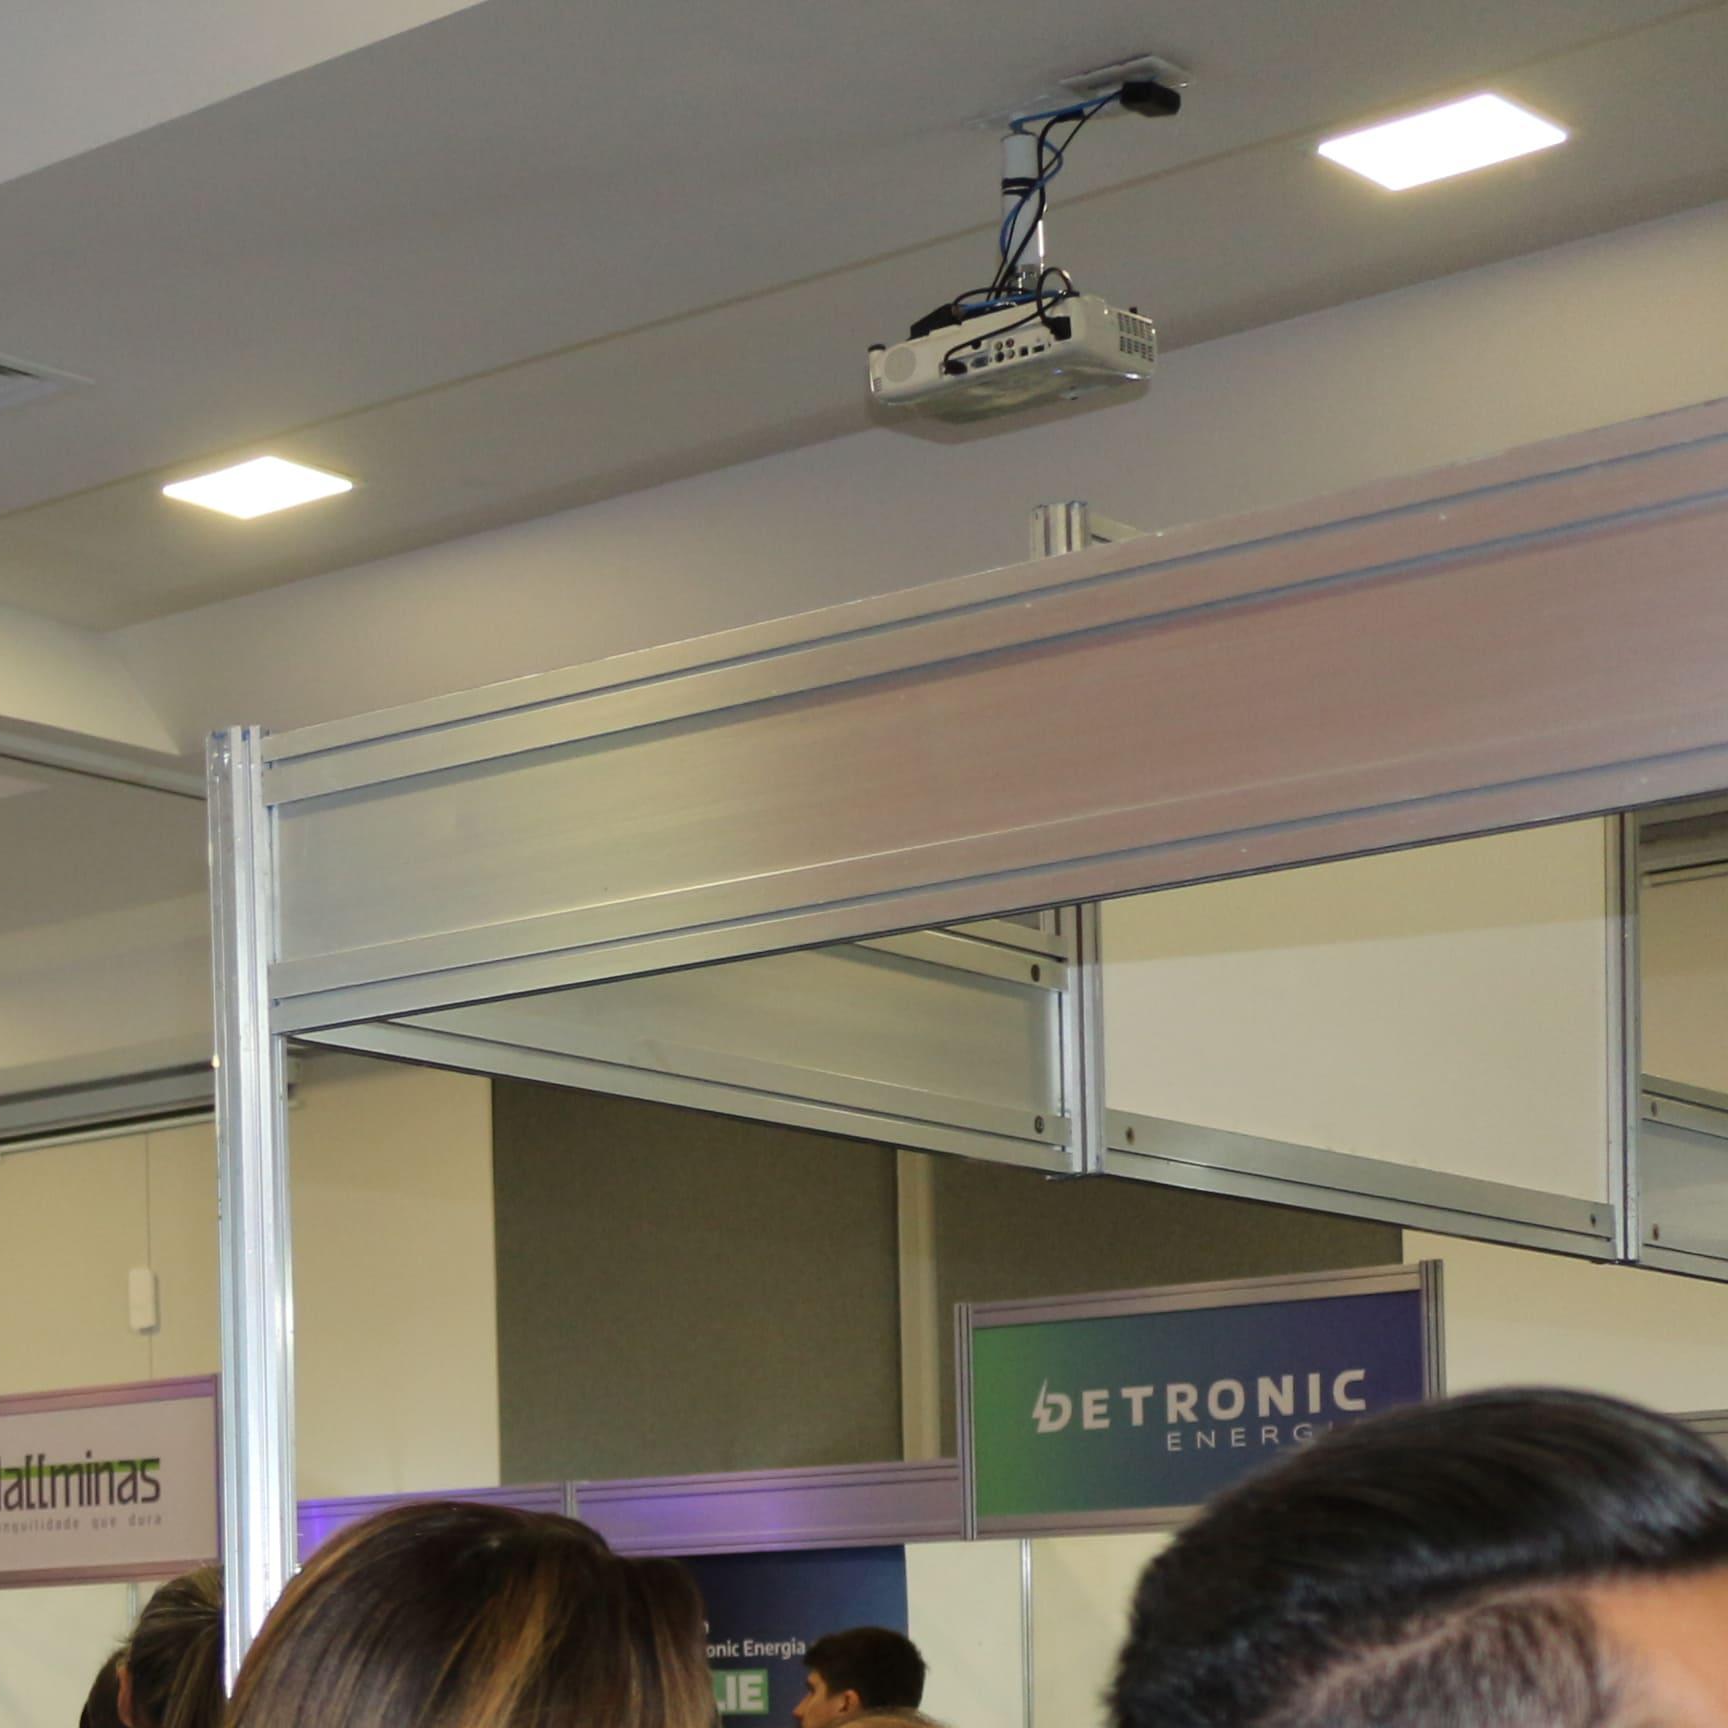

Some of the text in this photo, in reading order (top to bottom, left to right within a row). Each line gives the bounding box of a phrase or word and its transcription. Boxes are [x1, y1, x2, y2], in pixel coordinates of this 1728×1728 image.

[1032, 1368, 1366, 1433] DETRONIC
[1166, 1420, 1334, 1451] ENERG
[91, 1516, 118, 1531] que
[128, 1514, 162, 1527] dura
[706, 1636, 806, 1660] onic Energia
